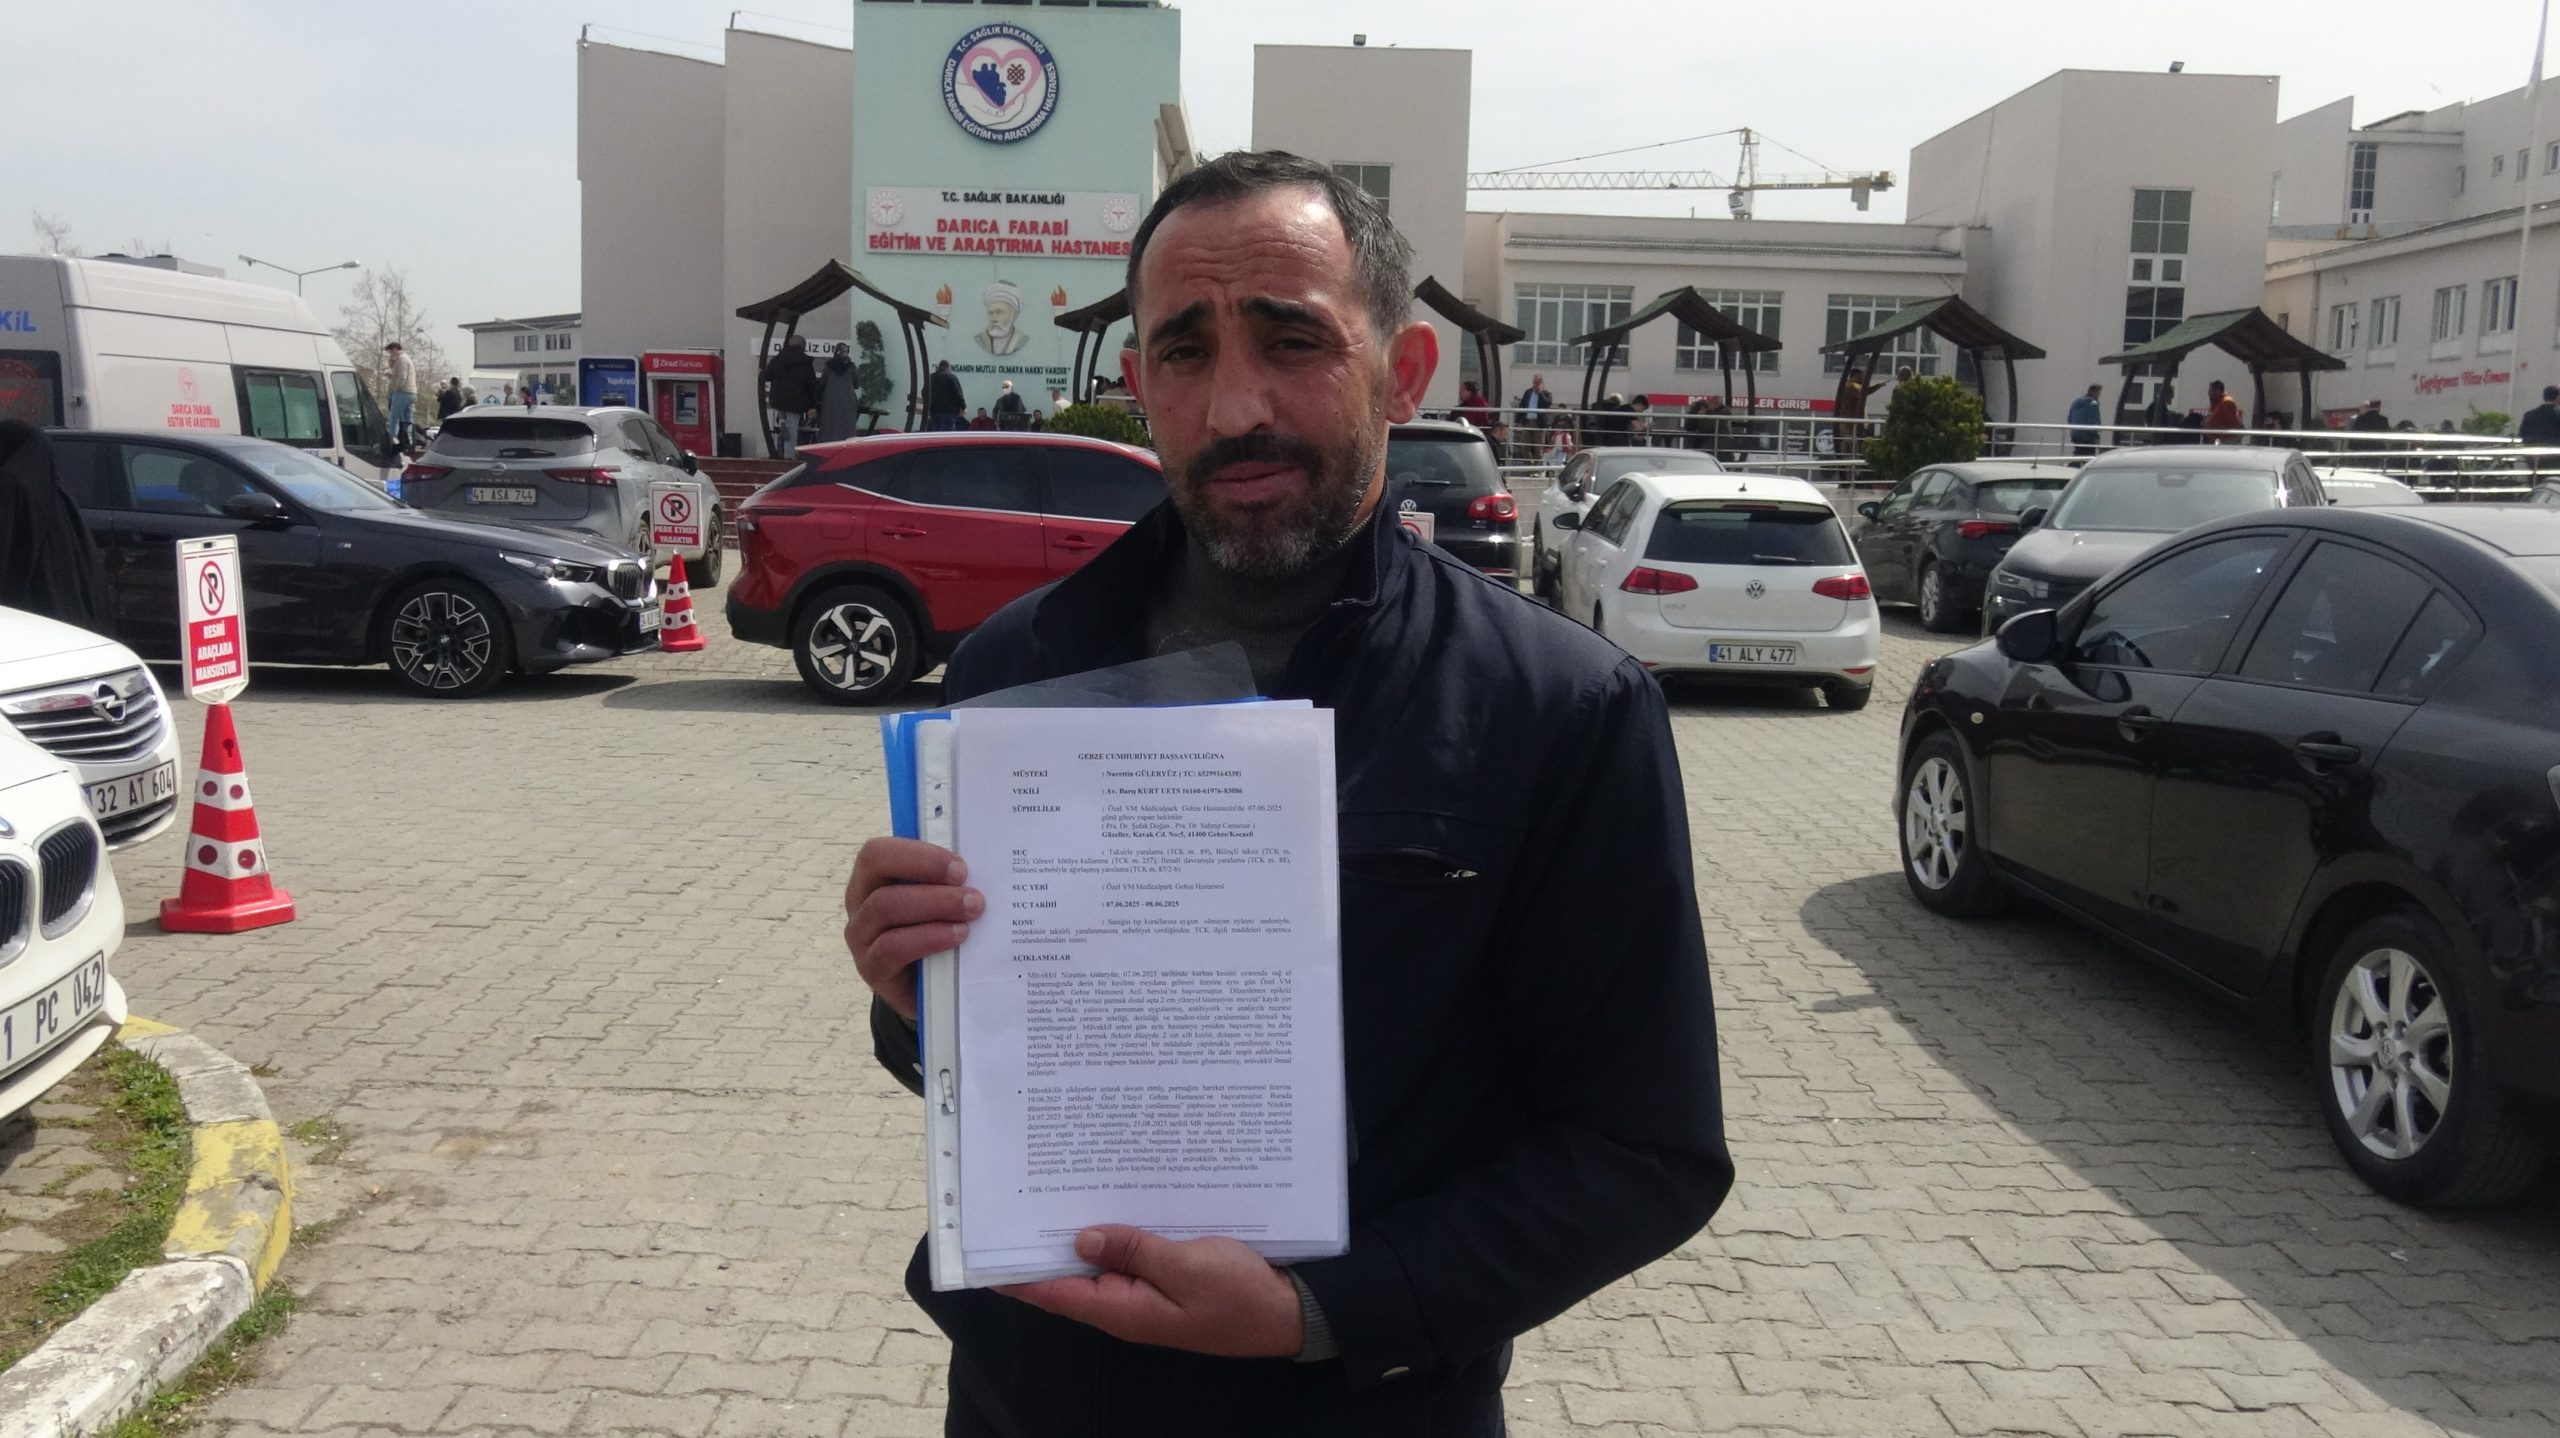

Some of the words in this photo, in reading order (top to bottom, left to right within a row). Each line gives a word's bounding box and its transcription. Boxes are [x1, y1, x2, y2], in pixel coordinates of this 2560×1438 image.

[970, 26, 1001, 41] SAĞLIK
[1002, 26, 1046, 54] BAKANLIĞI
[942, 191, 960, 202] T.C.
[963, 190, 1002, 204] SAĞLIK
[1005, 192, 1065, 205] BAKANLIĞI
[936, 218, 999, 235] DARICA
[1008, 218, 1068, 236] FARABİ
[869, 232, 921, 250] EĞİTİM
[926, 236, 946, 250] VE
[952, 238, 1044, 256] ARAŞTIRMA
[1051, 240, 1132, 256] HASTANES
[950, 364, 975, 373] NSANIN
[491, 489, 508, 500] ASA
[654, 526, 673, 534] PARK
[659, 535, 693, 545] YASAKTIR
[197, 641, 233, 661] ARAÇLARA
[1718, 647, 1732, 661] 41
[1739, 647, 1763, 662] ALY
[1770, 648, 1793, 662] 477
[1105, 752, 1158, 760] CUMHURİYET
[1159, 752, 1225, 761] BAŞSAVCILIĞINA
[1012, 769, 1048, 778] MÜŞTEKİ
[97, 787, 118, 814] 32
[129, 779, 145, 806] AT
[153, 771, 173, 801] 604
[1012, 787, 1040, 795] VEKİLİ
[1137, 787, 1159, 795] KURT
[1012, 804, 1061, 813] ŞÜPHELİLER
[1012, 884, 1028, 892] SUÇ
[1029, 883, 1048, 891] YERİ
[1012, 954, 1071, 962] AÇIKLAMALAR
[36, 990, 58, 1044] PC
[73, 960, 102, 1017] 042
